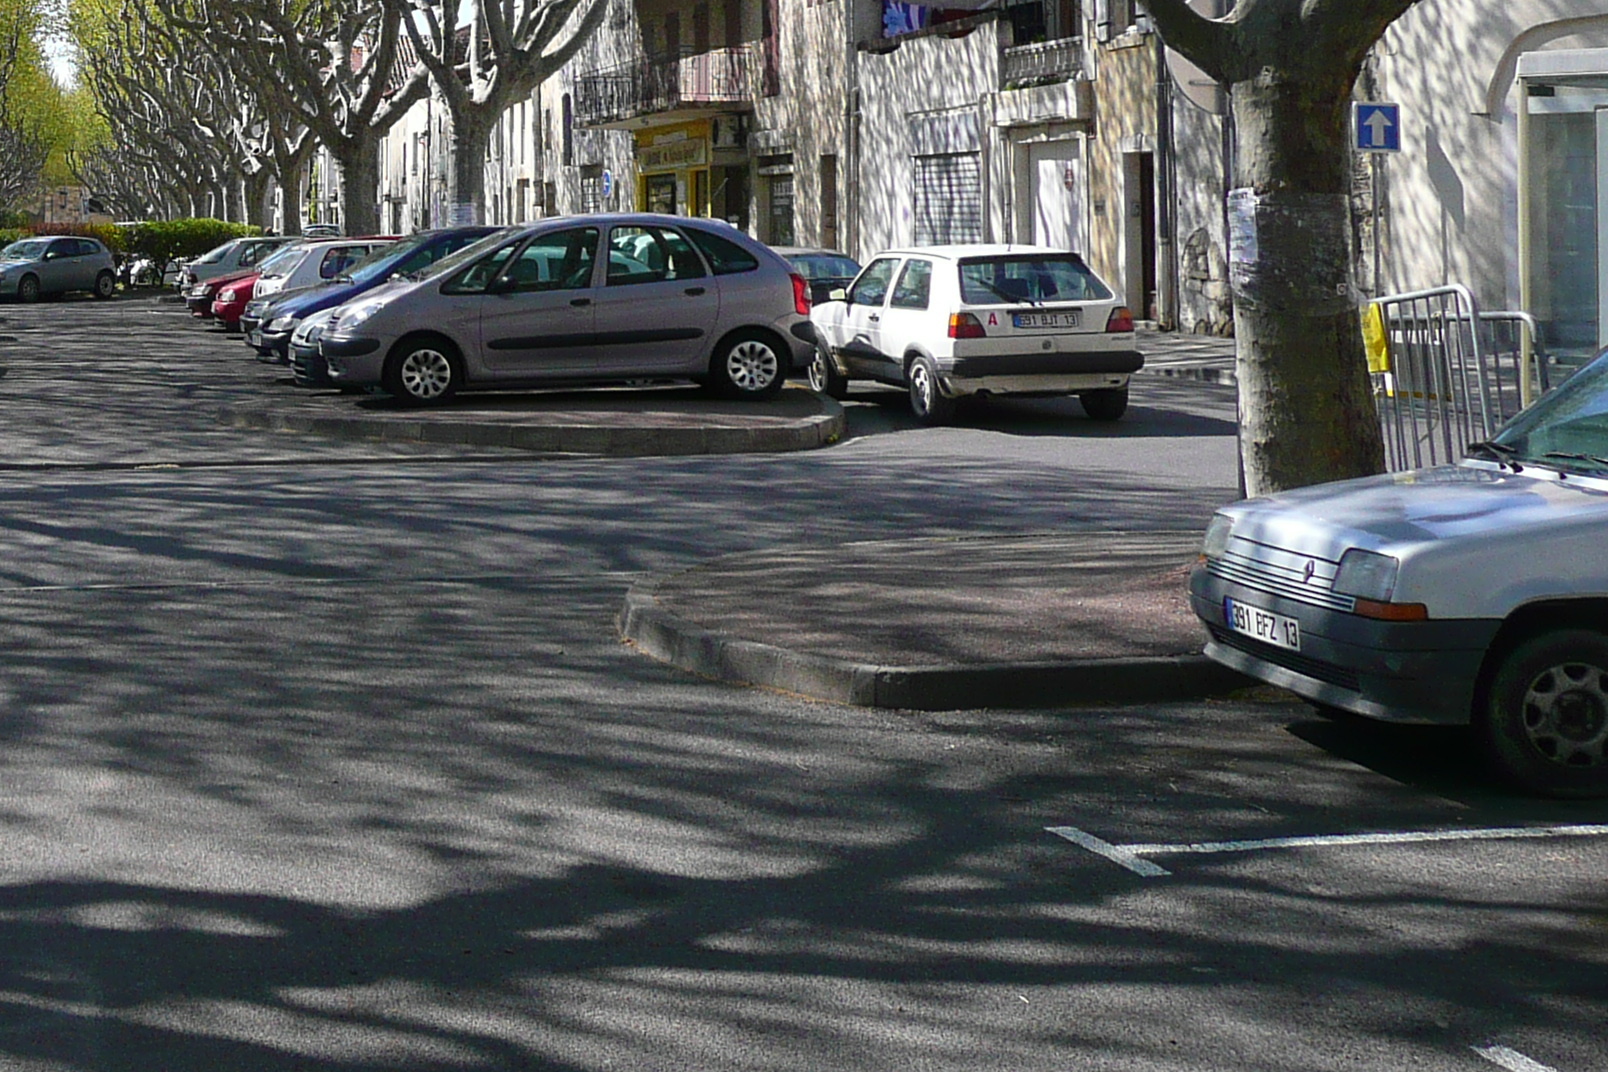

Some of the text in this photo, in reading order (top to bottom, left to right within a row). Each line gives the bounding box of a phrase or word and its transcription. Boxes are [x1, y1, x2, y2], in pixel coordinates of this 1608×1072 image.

[988, 312, 998, 325] A
[1064, 314, 1076, 325] 13
[1232, 604, 1251, 632] 391
[1283, 620, 1298, 647] 13
